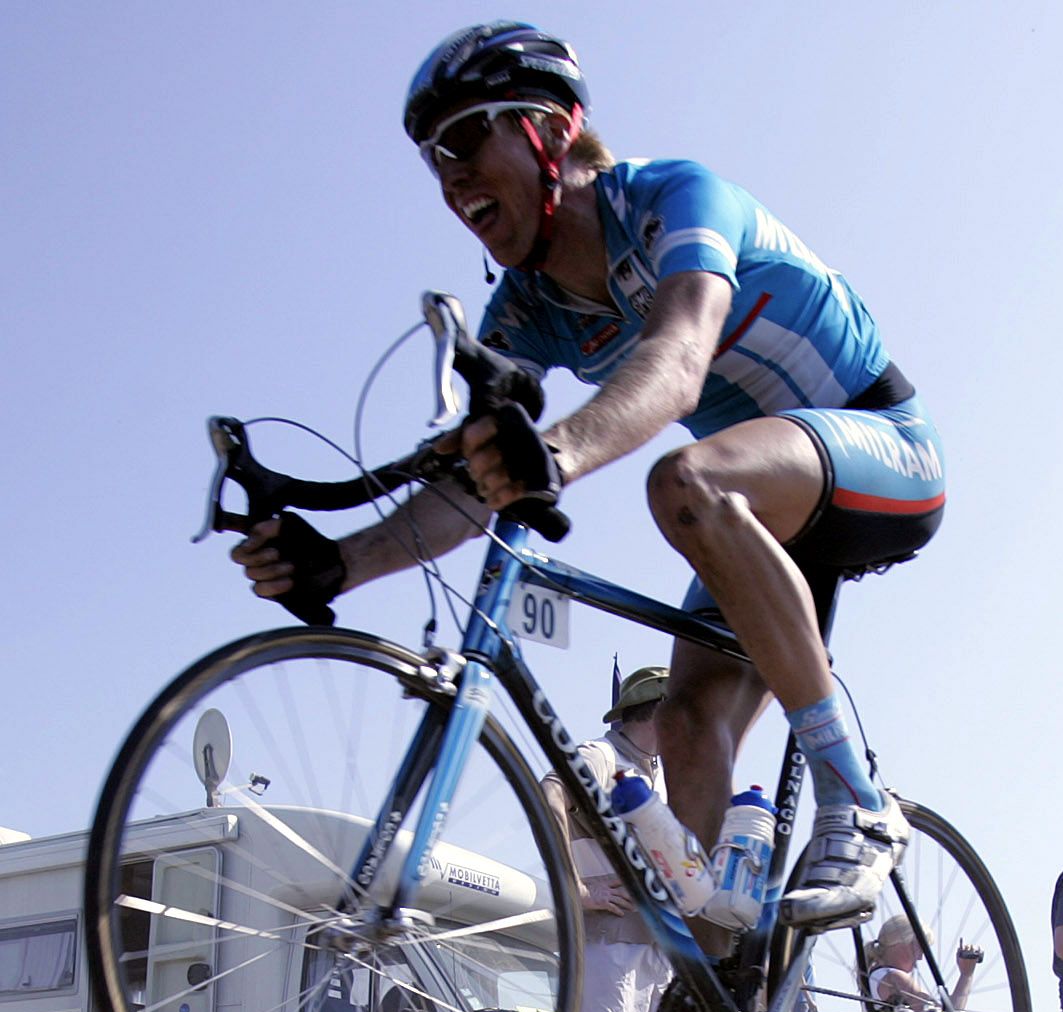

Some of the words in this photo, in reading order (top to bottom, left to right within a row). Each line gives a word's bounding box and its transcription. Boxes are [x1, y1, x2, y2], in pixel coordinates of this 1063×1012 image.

[824, 411, 943, 481] MILRAM
[522, 593, 555, 639] 90
[532, 689, 669, 902] COLNAGO
[777, 743, 807, 836] OLNAGO
[448, 866, 501, 891] MOBILVETTA
